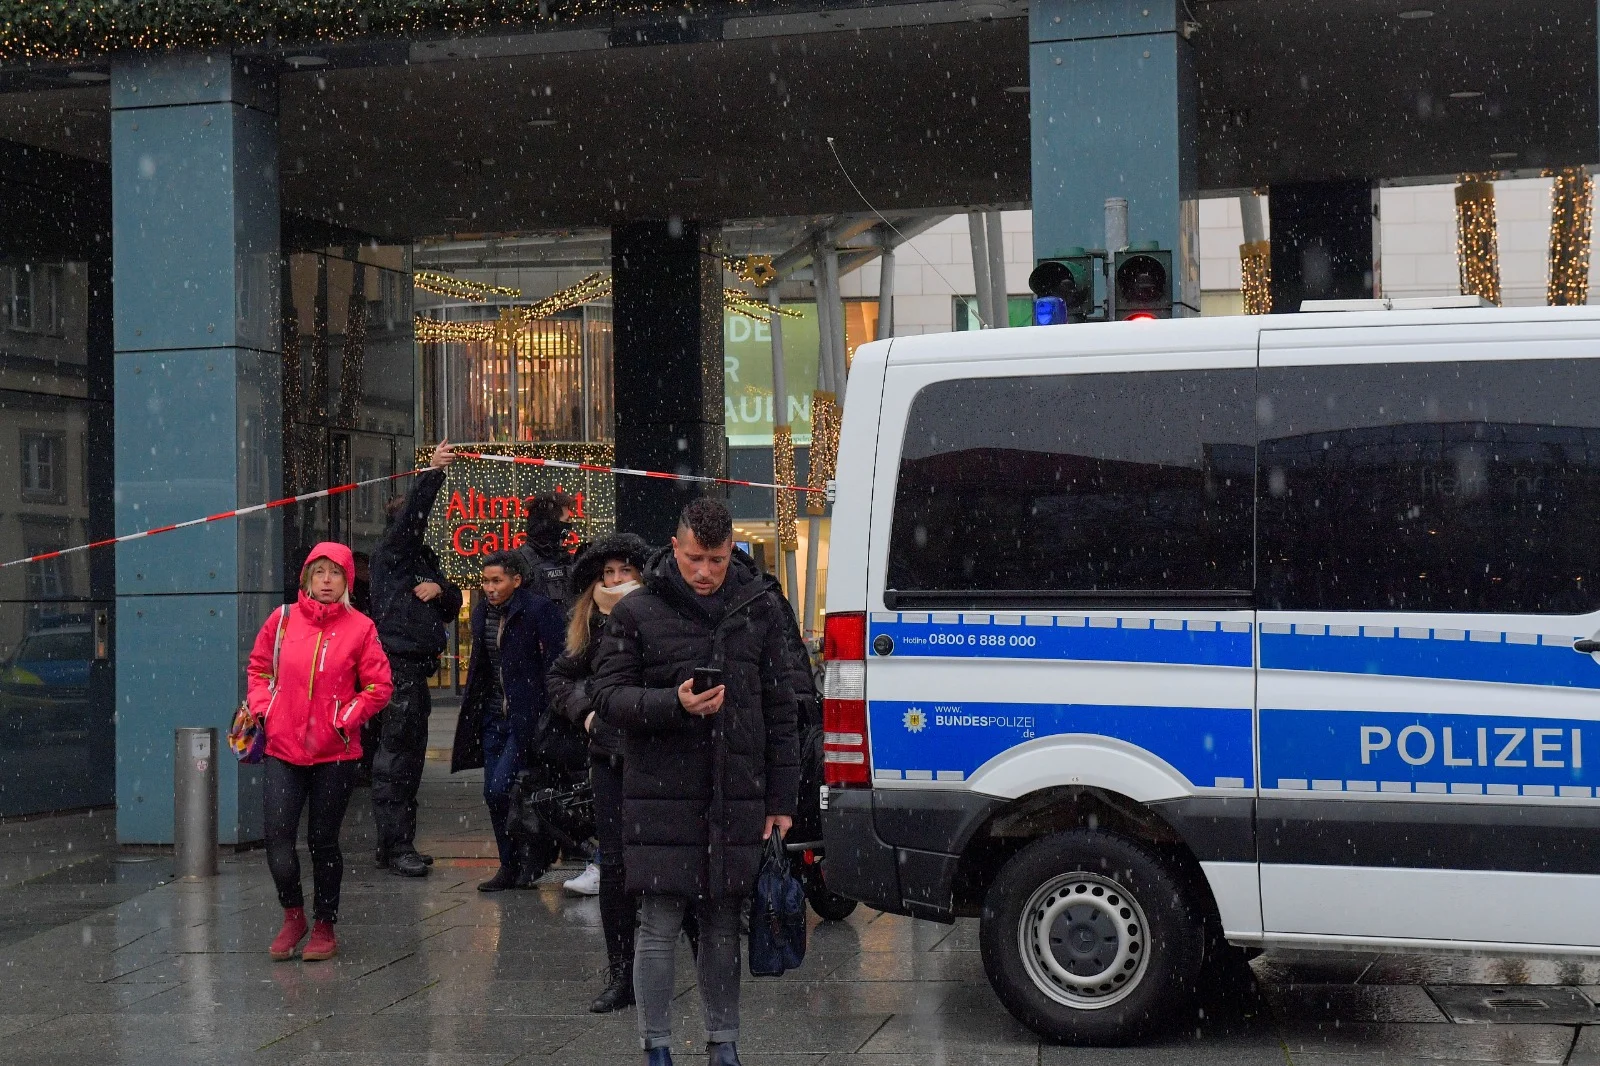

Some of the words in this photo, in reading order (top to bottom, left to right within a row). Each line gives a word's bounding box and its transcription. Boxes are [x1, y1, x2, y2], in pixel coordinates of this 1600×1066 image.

[724, 315, 772, 342] DE
[453, 522, 579, 557] Galee
[902, 636, 927, 645] Hotline
[928, 633, 965, 645] 0800
[967, 634, 977, 646] 6
[979, 634, 1007, 646] 888
[1009, 635, 1036, 647] 000
[934, 705, 963, 714] www.
[935, 715, 1035, 728] BUNDESPOLIZEI
[1360, 724, 1582, 769] POLIZEI
